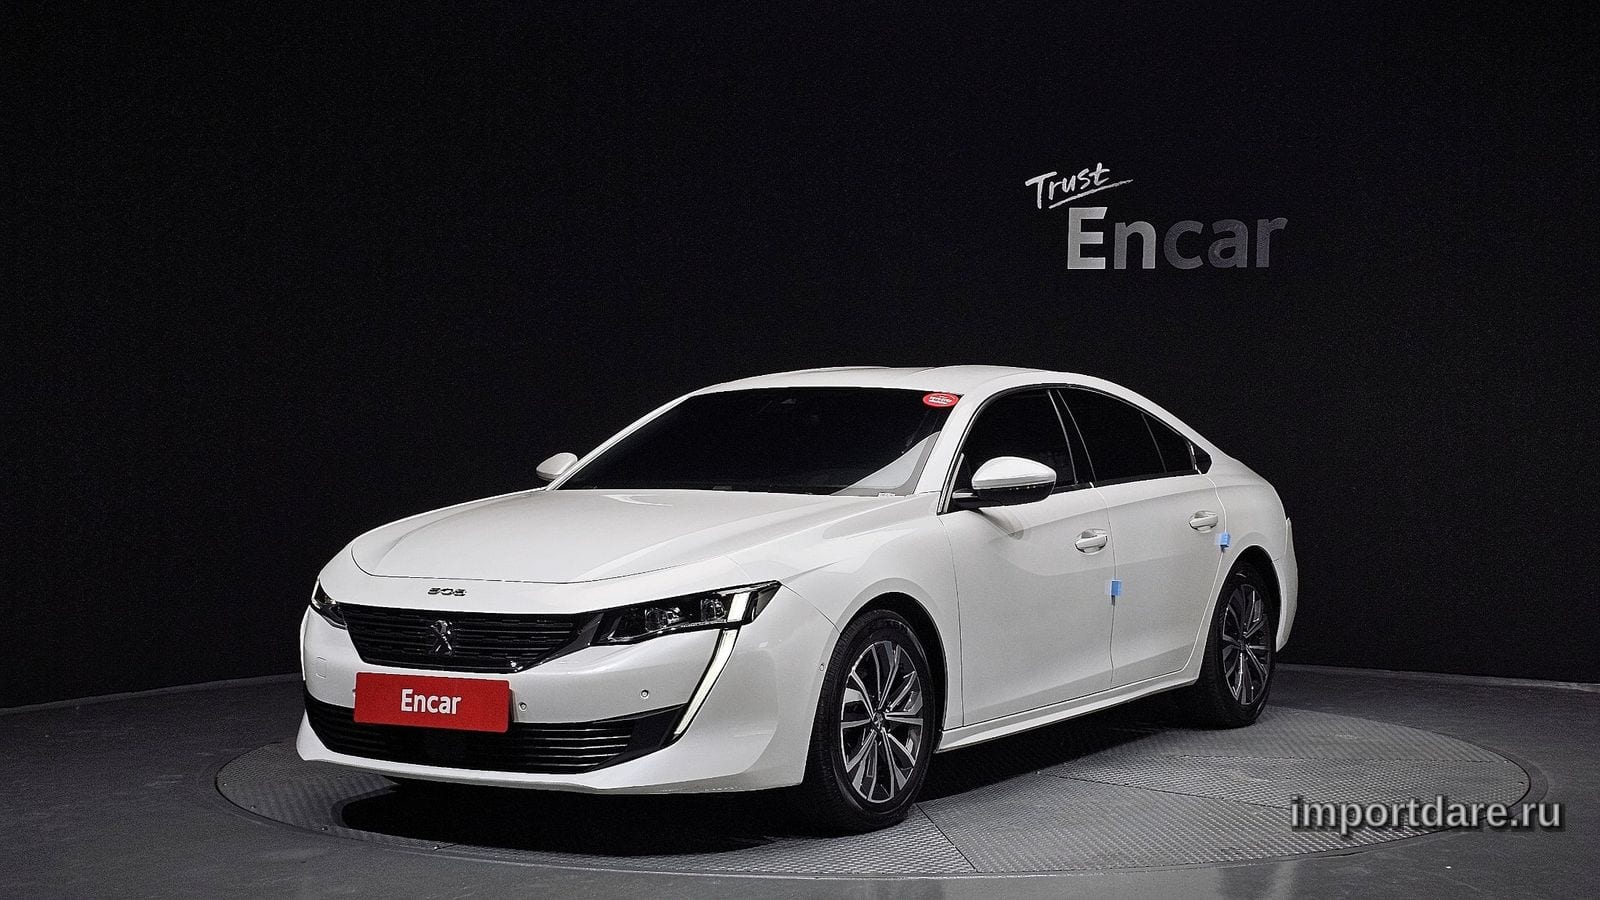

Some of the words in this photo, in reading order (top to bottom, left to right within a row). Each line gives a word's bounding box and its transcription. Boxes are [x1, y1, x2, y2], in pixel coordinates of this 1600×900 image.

[1025, 162, 1111, 209] Trust
[1067, 206, 1289, 270] Encar
[400, 688, 462, 715] Encar
